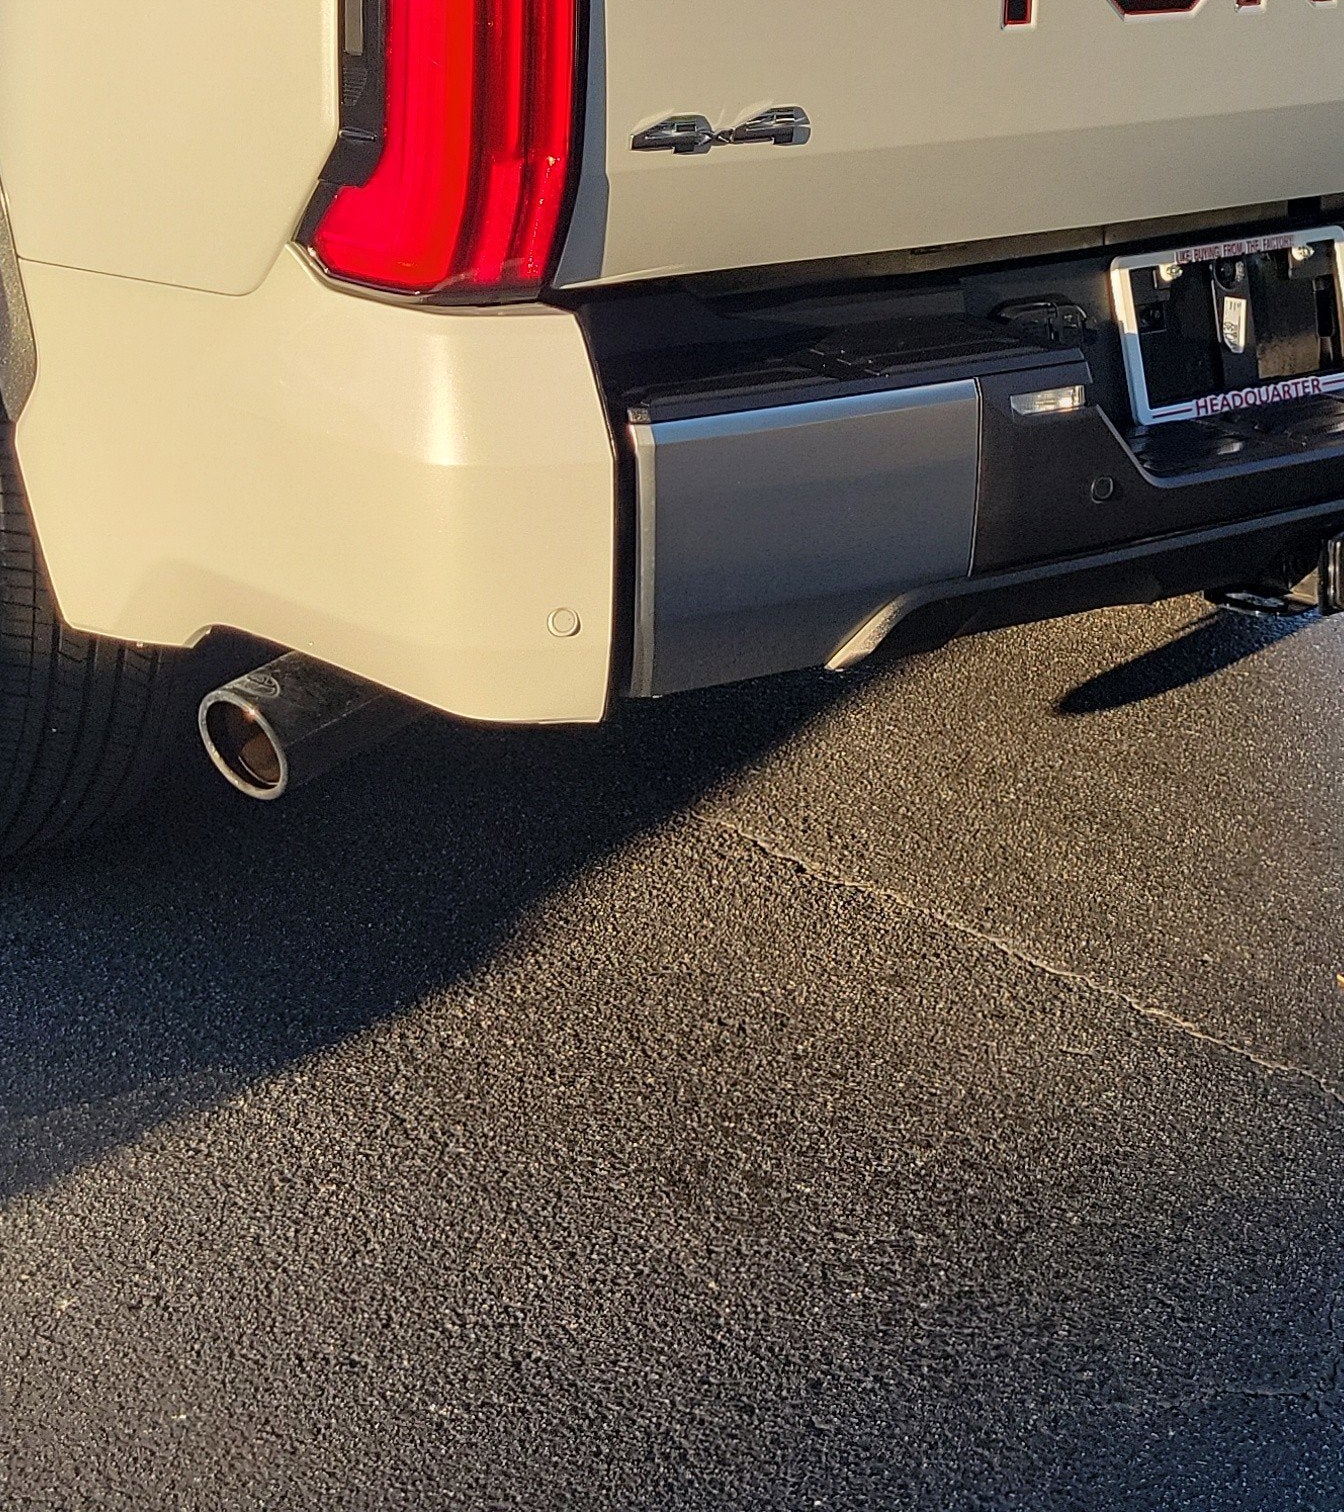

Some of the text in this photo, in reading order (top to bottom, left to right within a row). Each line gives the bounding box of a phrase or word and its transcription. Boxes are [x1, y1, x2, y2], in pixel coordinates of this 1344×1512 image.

[1193, 245, 1221, 262] BUYING
[1222, 242, 1244, 257] FROM
[1246, 239, 1260, 254] THE
[1195, 376, 1323, 417] HEADQUARTER
